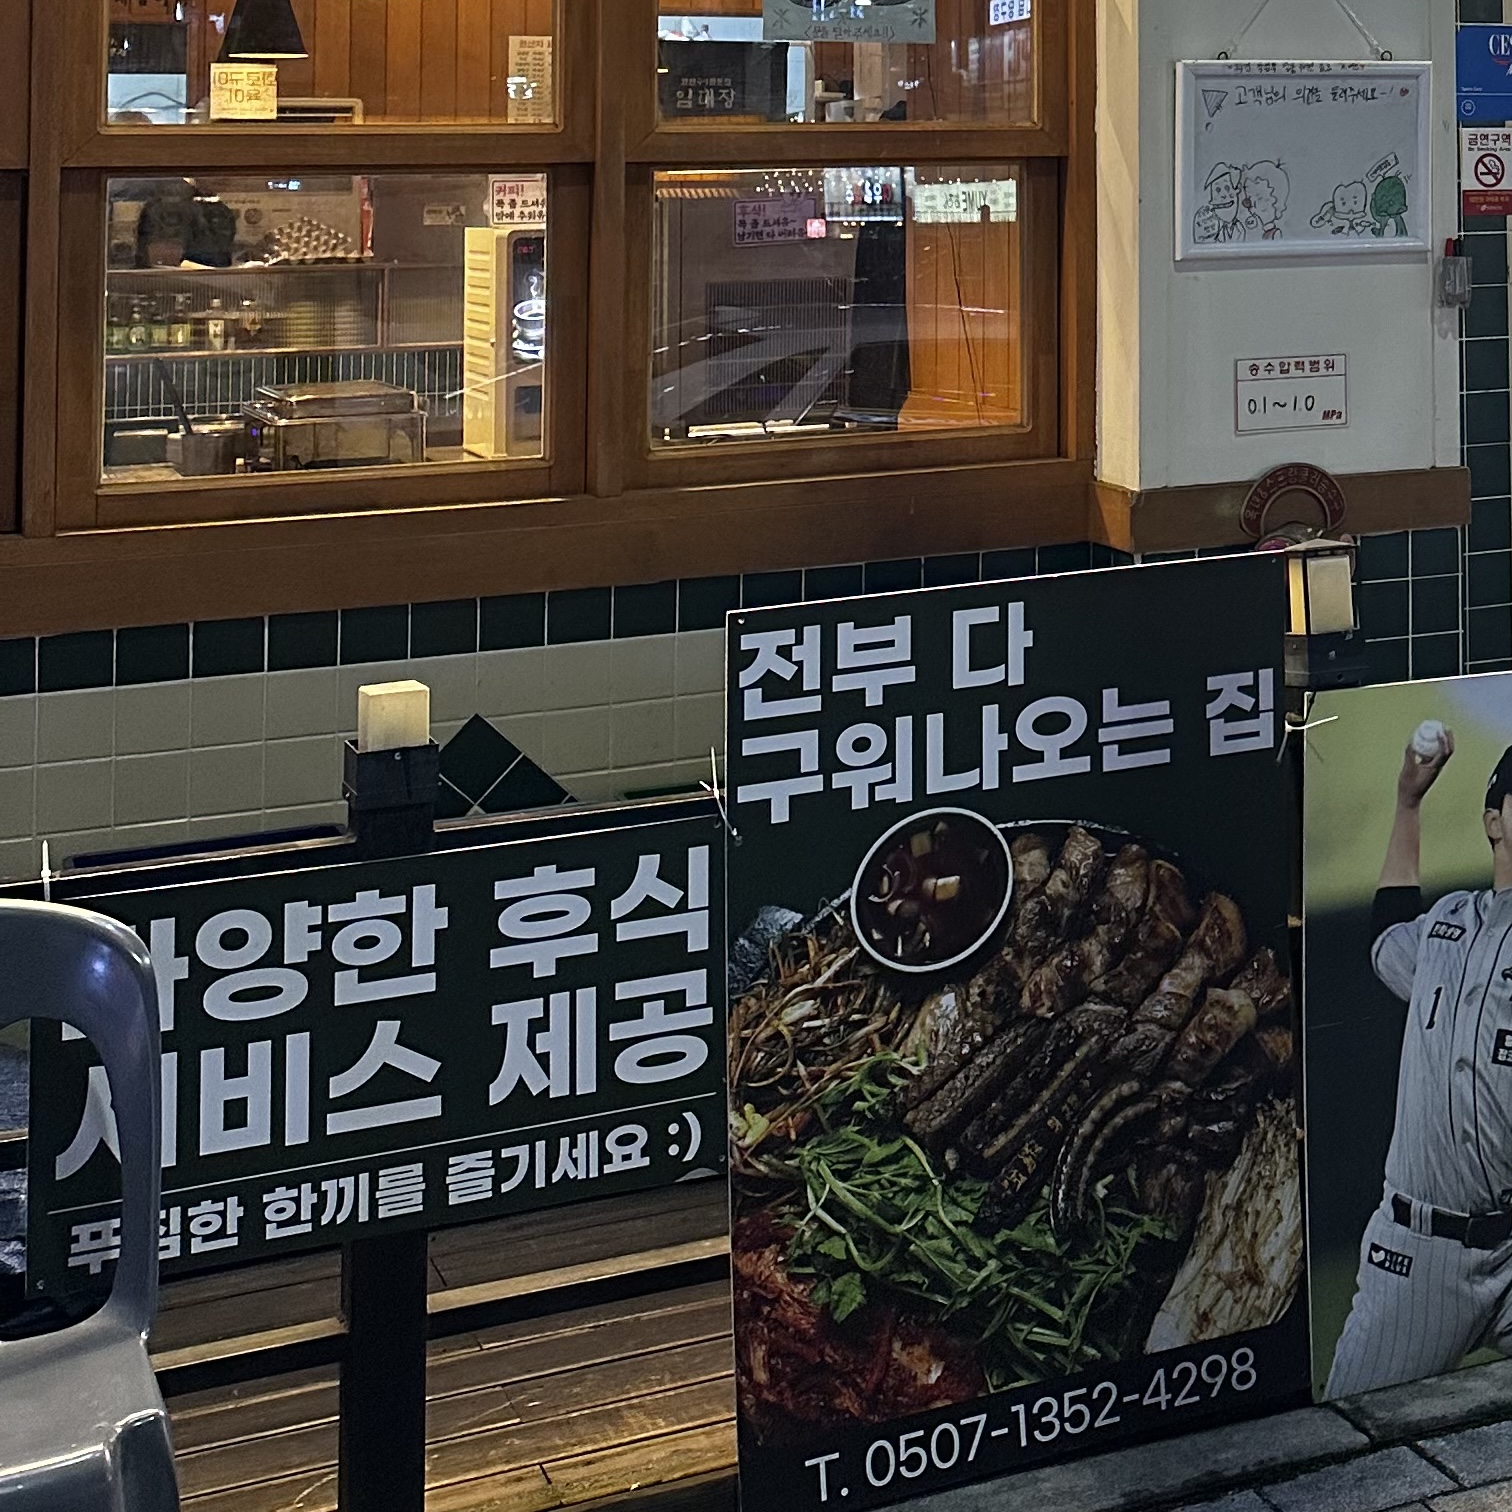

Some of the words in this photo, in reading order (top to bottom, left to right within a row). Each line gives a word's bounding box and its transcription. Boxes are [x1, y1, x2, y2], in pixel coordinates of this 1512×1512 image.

[676, 88, 736, 108] 임대장
[1468, 133, 1511, 146] 금연구역
[1249, 358, 1335, 377] 송수압력범위
[1321, 409, 1343, 421] MPa
[738, 615, 916, 722] 전부
[952, 601, 1034, 690] 다
[737, 688, 1175, 825] 구워나오는
[1205, 668, 1276, 757] 집
[490, 845, 711, 979] 후식
[490, 969, 714, 1108] 제공
[262, 1161, 427, 1241] 한끼를
[445, 1122, 650, 1207] 즐기세요
[804, 1451, 850, 1503] T.
[865, 1346, 1258, 1488] 0507-1352-4298
